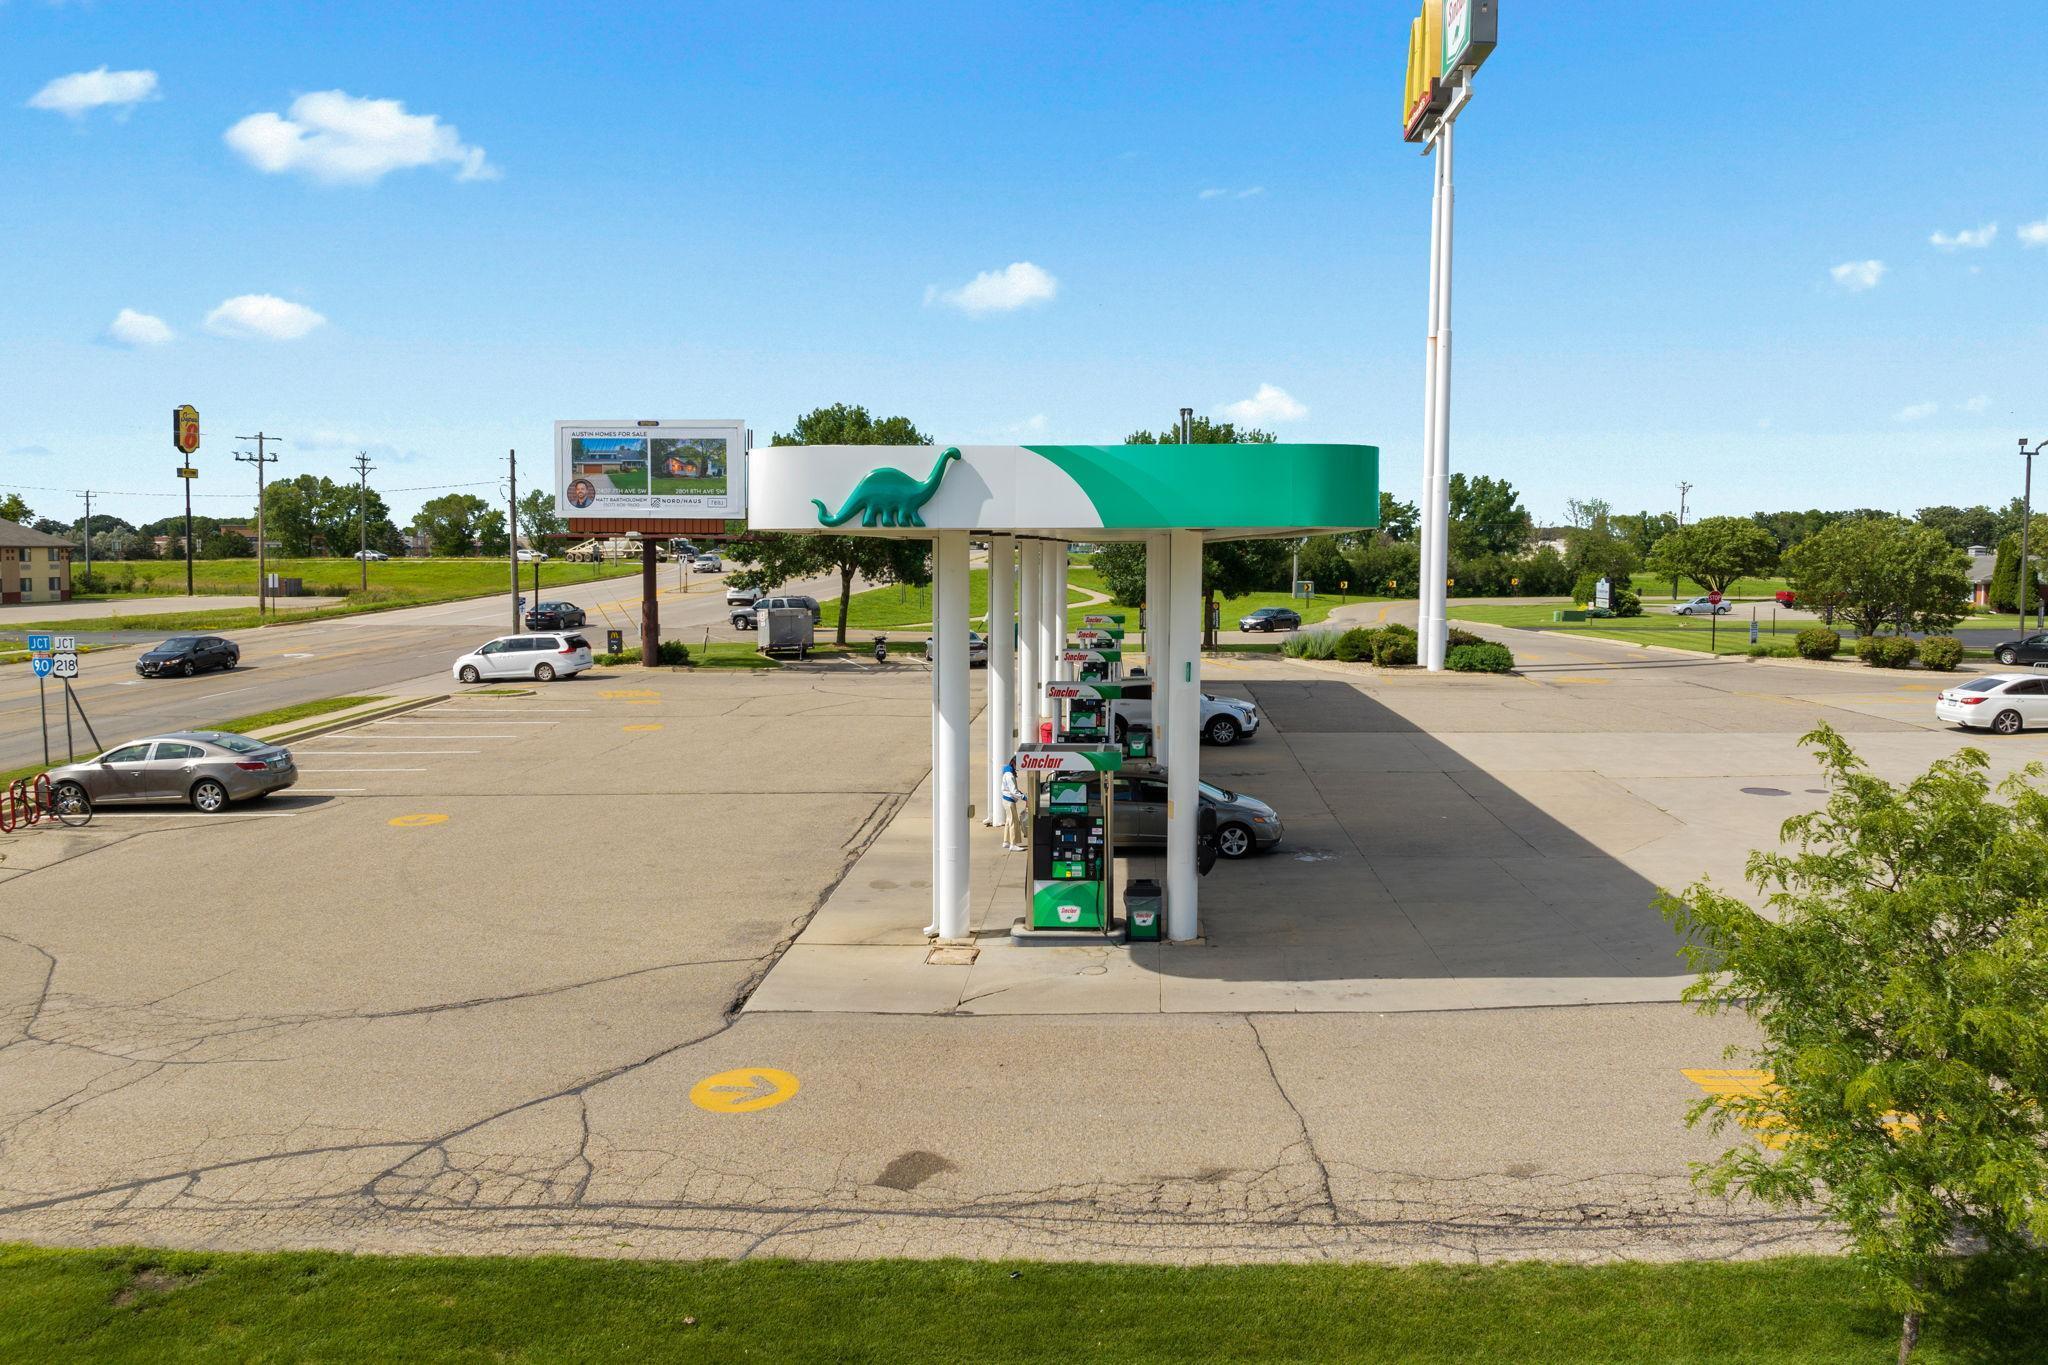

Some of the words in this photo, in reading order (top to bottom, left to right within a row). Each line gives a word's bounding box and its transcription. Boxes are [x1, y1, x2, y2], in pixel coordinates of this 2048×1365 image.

[185, 424, 197, 448] 8
[1078, 630, 1098, 639] Sinclair
[31, 638, 48, 649] JCT
[56, 638, 74, 649] JCT
[1064, 652, 1089, 661] Sinclair
[34, 660, 50, 672] 90
[56, 660, 76, 671] 218
[1048, 686, 1080, 698] Sinclair
[1021, 753, 1064, 769] Sinclair
